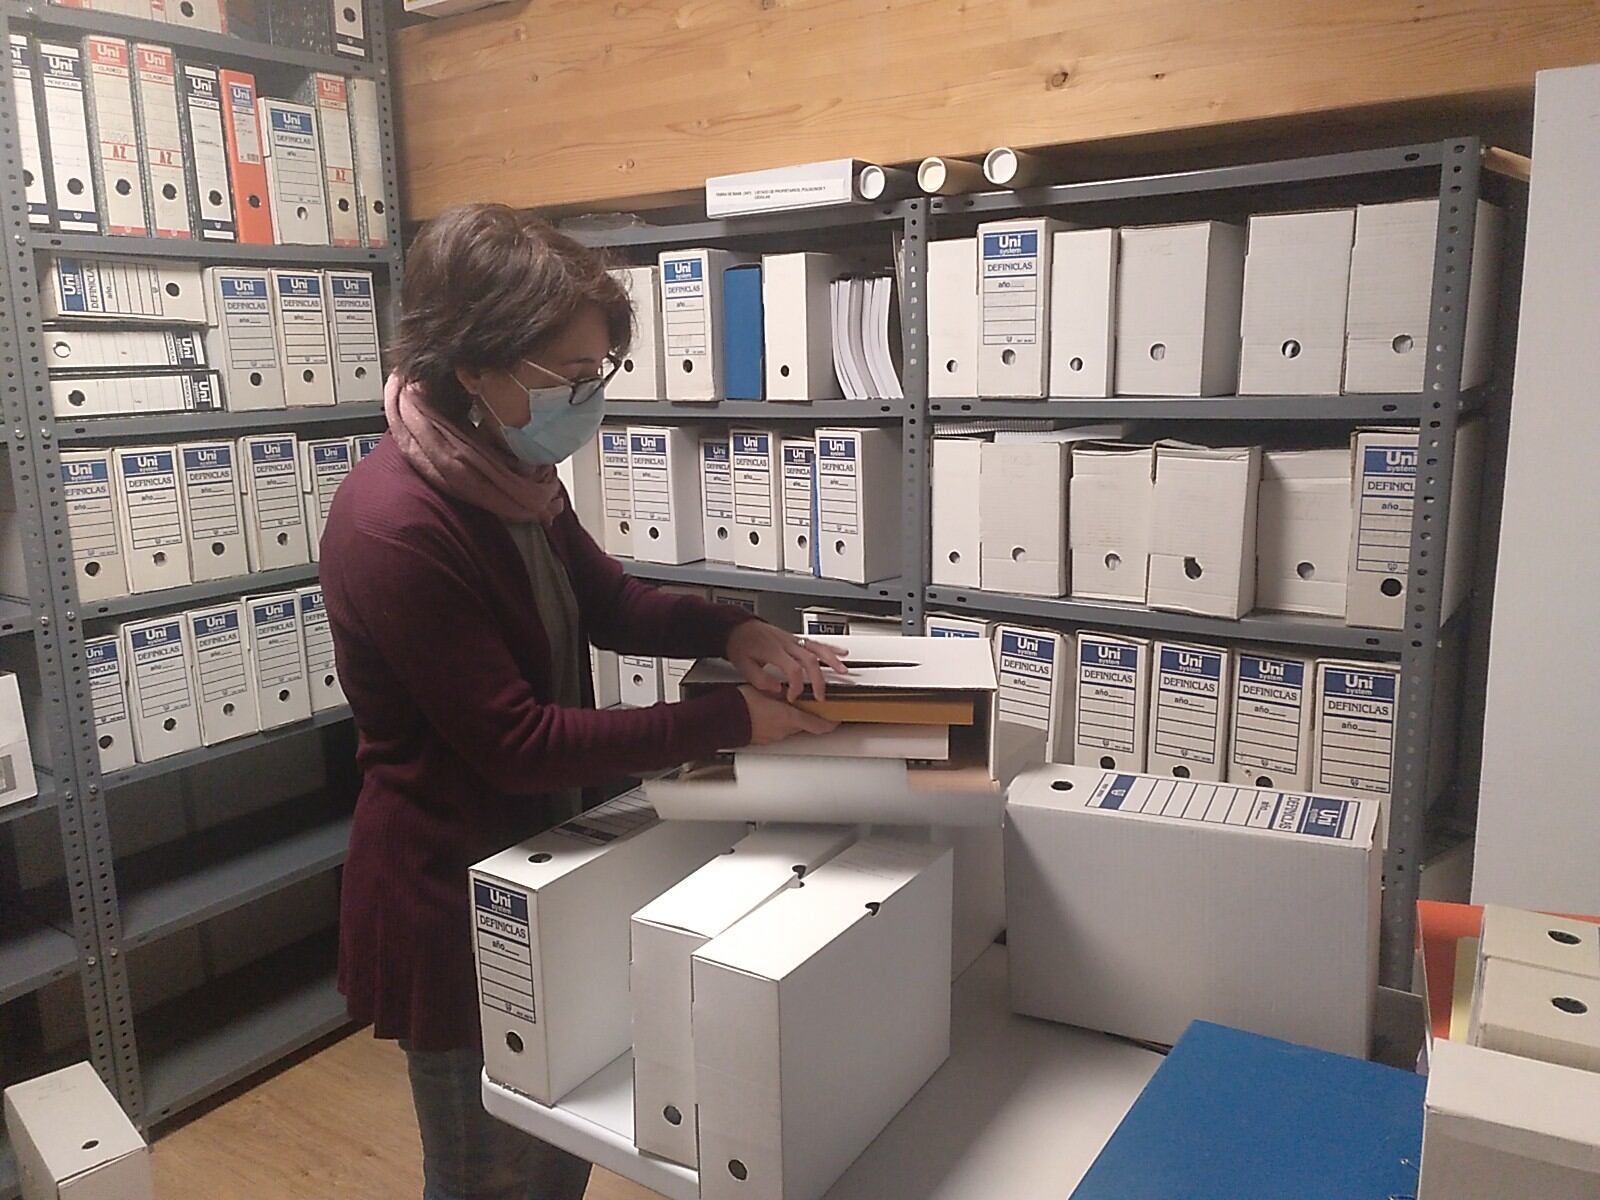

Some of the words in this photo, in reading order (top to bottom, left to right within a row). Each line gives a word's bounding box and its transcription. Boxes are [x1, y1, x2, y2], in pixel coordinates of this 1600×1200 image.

[97, 43, 120, 58] Uni
[50, 56, 74, 71] Uni
[144, 52, 166, 67] Uni
[192, 78, 213, 91] Uni
[323, 80, 341, 93] Uni
[233, 88, 250, 99] Uni
[283, 111, 301, 125] Uni
[999, 235, 1022, 248] Uni
[1000, 247, 1022, 255] system
[672, 261, 692, 275] Uni
[987, 261, 1033, 274] DEFINICLAS
[63, 273, 76, 295] Uni
[234, 279, 254, 292] Uni
[290, 278, 309, 291] Uni
[341, 278, 360, 291] Uni
[668, 284, 700, 295] DEFINICLAS
[998, 281, 1012, 289] año
[226, 301, 266, 312] DEFINICLAS
[283, 299, 321, 309] DEFINICLAS
[336, 299, 370, 309] DEFINICLAS
[181, 337, 195, 360] Uni
[198, 380, 212, 403] Uni
[640, 436, 656, 448] Uni
[743, 436, 758, 448] Uni
[829, 439, 846, 452] Uni
[198, 449, 217, 463] Uni
[263, 444, 282, 456] Uni
[324, 447, 339, 458] Uni
[713, 445, 726, 456] Uni
[792, 449, 806, 459] Uni
[137, 455, 158, 470] Uni
[633, 456, 665, 467] DEFINICLAS
[736, 457, 767, 467] DEFINICLAS
[1386, 451, 1417, 466] Uni
[68, 464, 92, 478] Uni
[256, 462, 292, 474] DEFINICLAS
[317, 462, 348, 473] DEFINICLAS
[822, 462, 853, 473] DEFINICLAS
[1386, 464, 1416, 473] system
[189, 468, 229, 481] DEFINICLAS
[129, 475, 171, 489] DEFINICLAS
[1381, 501, 1399, 511] año
[265, 604, 283, 617] Uni
[206, 615, 226, 628] Uni
[146, 627, 167, 642] Uni
[258, 622, 293, 635] DEFINICLAS
[819, 624, 835, 633] Uni
[199, 633, 237, 647] DEFINICLAS
[1017, 637, 1039, 651] Uni
[86, 647, 104, 659] Uni
[137, 646, 179, 660] DEFINICLAS
[1017, 648, 1038, 657] system
[1098, 646, 1121, 660] Uni
[1003, 659, 1050, 675] DEFINICLAS
[1098, 657, 1121, 665] system
[1178, 653, 1203, 668] Uni
[1179, 665, 1202, 674] system
[1259, 661, 1284, 676] Uni
[1013, 678, 1027, 687] año
[1084, 669, 1133, 684] DEFINICLAS
[1259, 673, 1283, 682] system
[1345, 674, 1374, 690] Uni
[1163, 676, 1216, 692] DEFINICLAS
[1095, 688, 1109, 697] año
[1242, 685, 1298, 701] DEFINICLAS
[1346, 687, 1373, 697] system
[1174, 696, 1189, 706] año
[1328, 700, 1389, 715] DEFINICLAS
[1254, 705, 1270, 715] año
[1341, 721, 1358, 730] año
[1279, 796, 1301, 830] DEFINICLAS
[1318, 809, 1339, 826] Uni
[490, 889, 512, 908] Uni
[480, 914, 525, 939] DEFINICLAS
